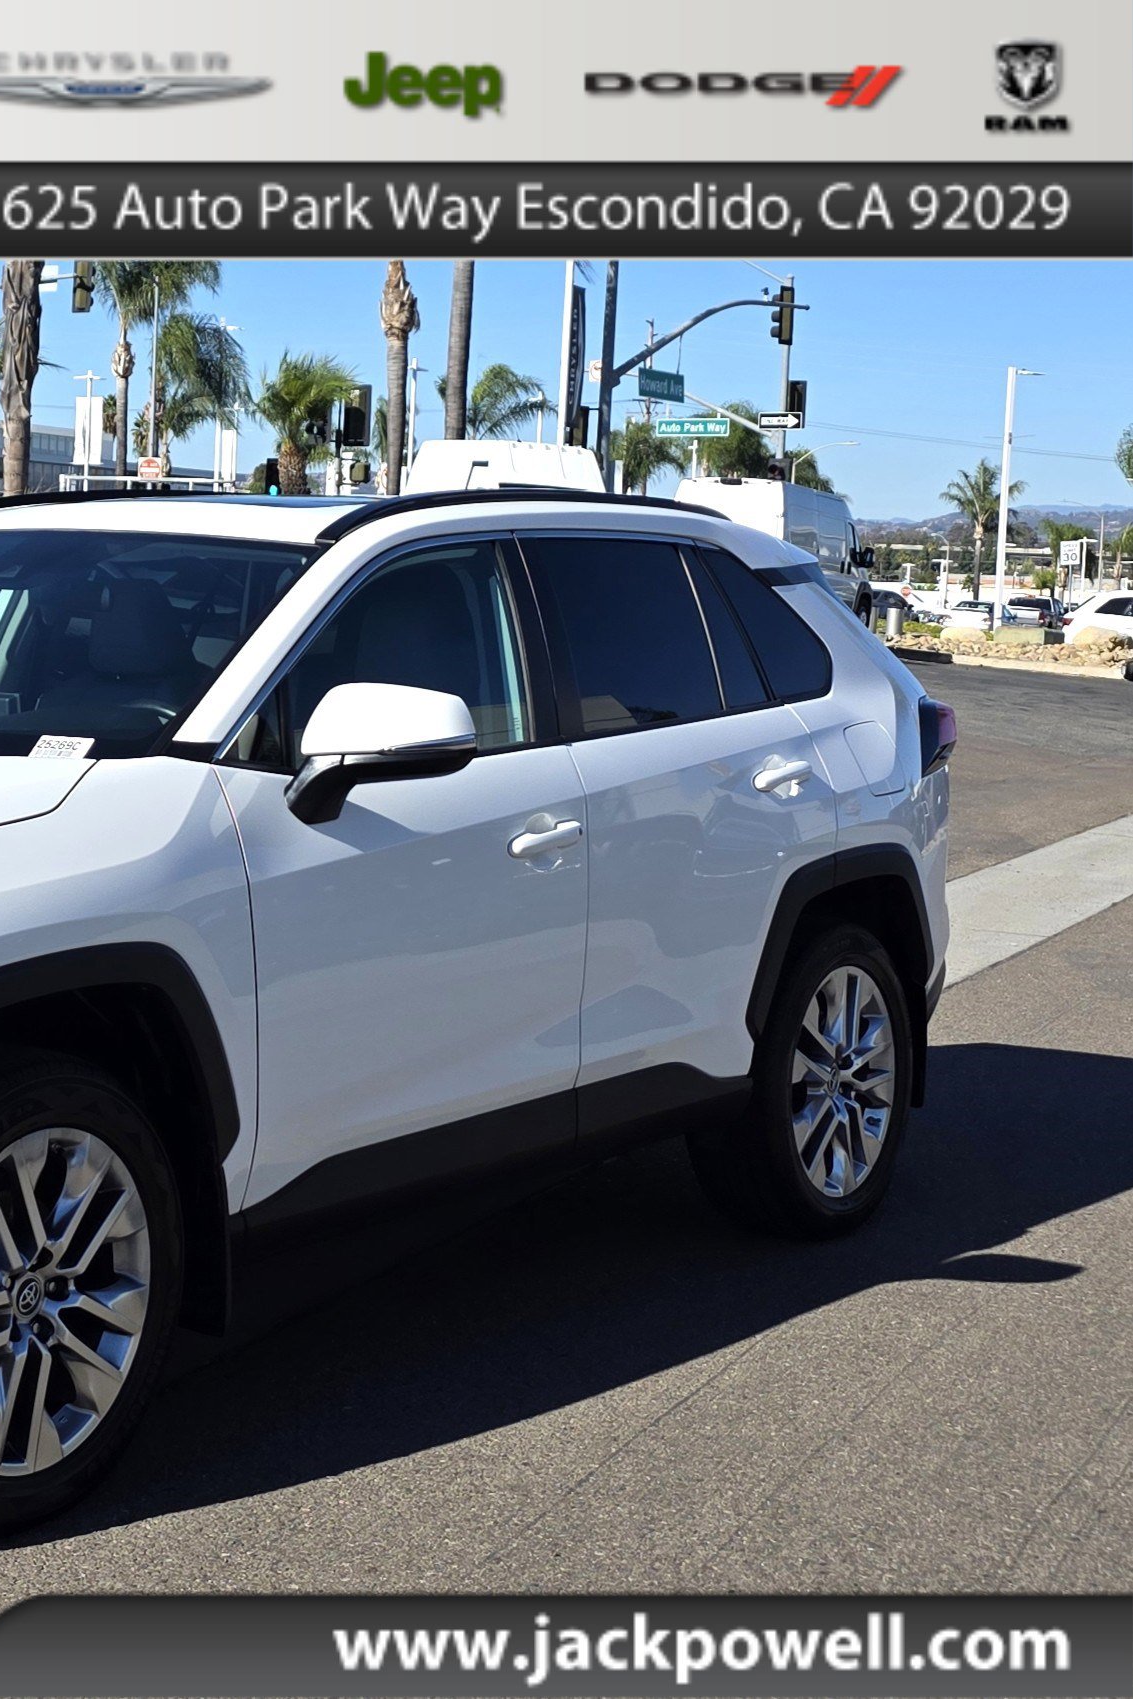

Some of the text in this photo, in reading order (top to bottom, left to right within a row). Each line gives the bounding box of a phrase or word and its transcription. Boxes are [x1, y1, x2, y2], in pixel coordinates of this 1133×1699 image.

[640, 373, 683, 397] Howard Ave
[659, 422, 727, 434] Auto Park Way
[1062, 552, 1078, 561] 30
[36, 739, 82, 751] 25269C
